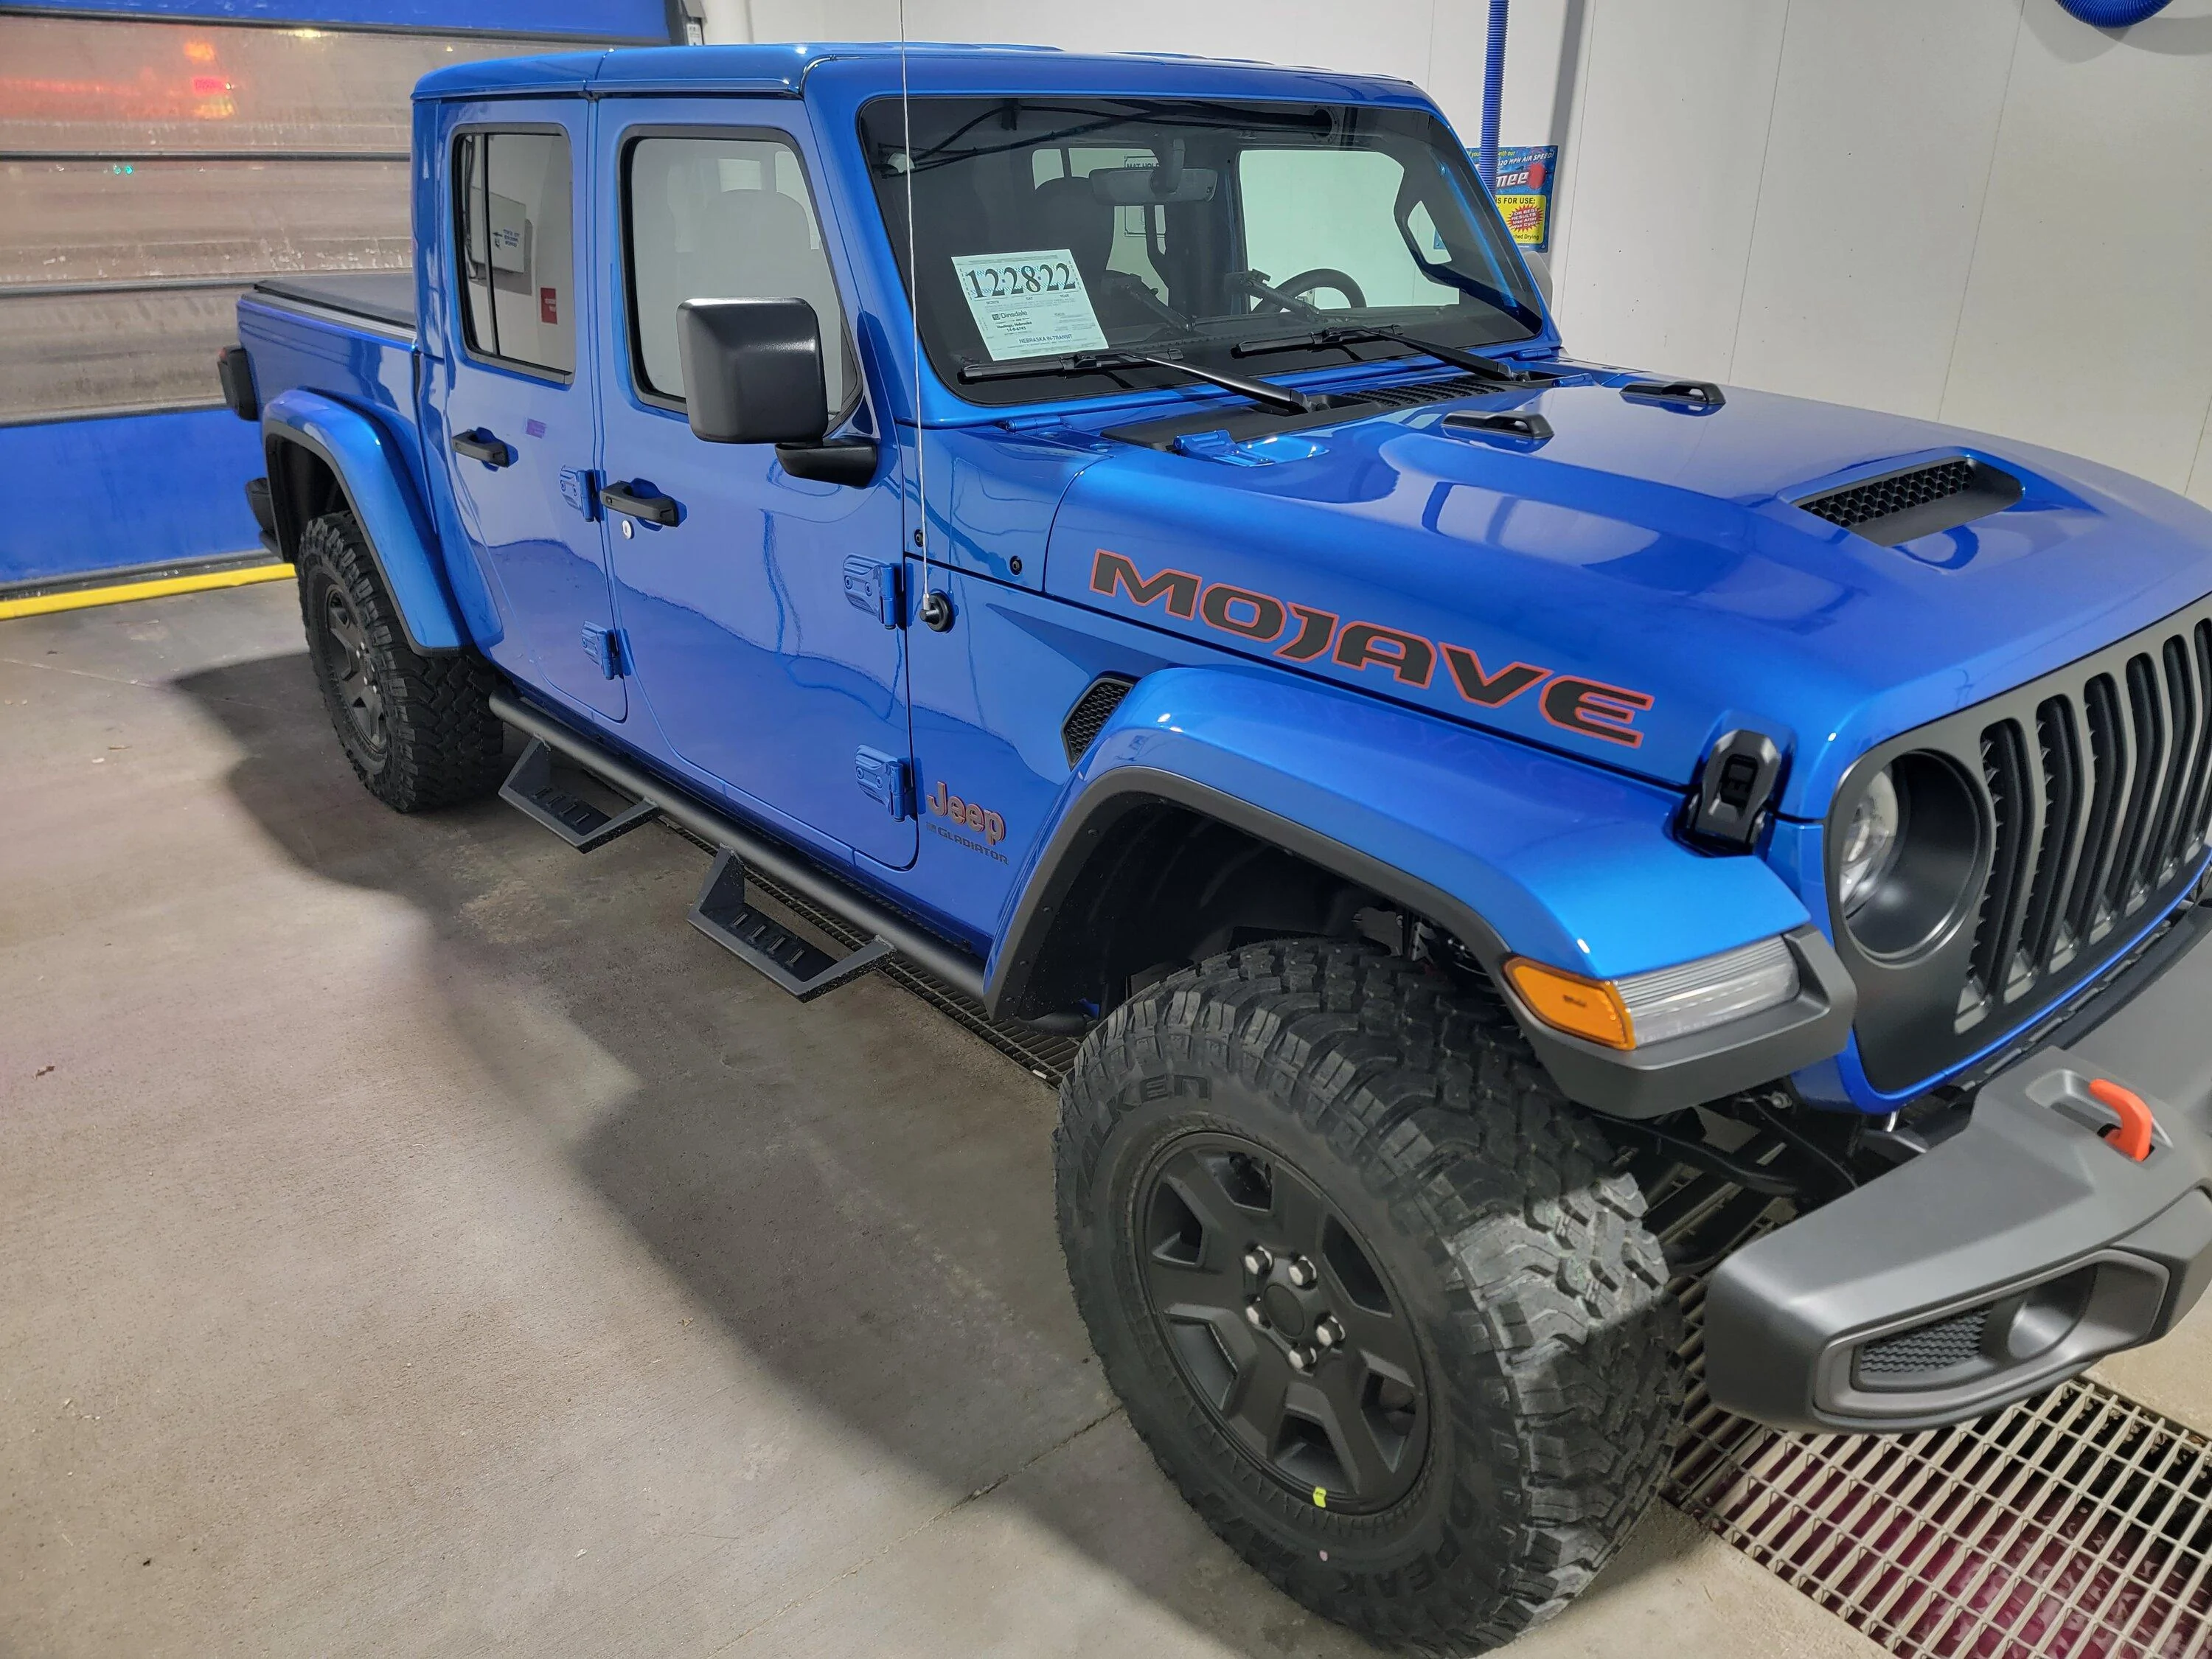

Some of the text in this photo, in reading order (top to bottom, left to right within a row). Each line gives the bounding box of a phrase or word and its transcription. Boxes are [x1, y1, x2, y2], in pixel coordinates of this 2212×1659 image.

[1509, 157, 1521, 165] MPH
[1533, 152, 1554, 161] SPEED!
[1512, 212, 1537, 220] RESULTS
[1001, 310, 1028, 319] Dinsdale
[1047, 333, 1073, 341] IN-TRANSIT
[1088, 549, 1655, 749] MOJAVE
[926, 781, 1006, 846] Jeep
[937, 826, 1009, 866] GLADIATOR
